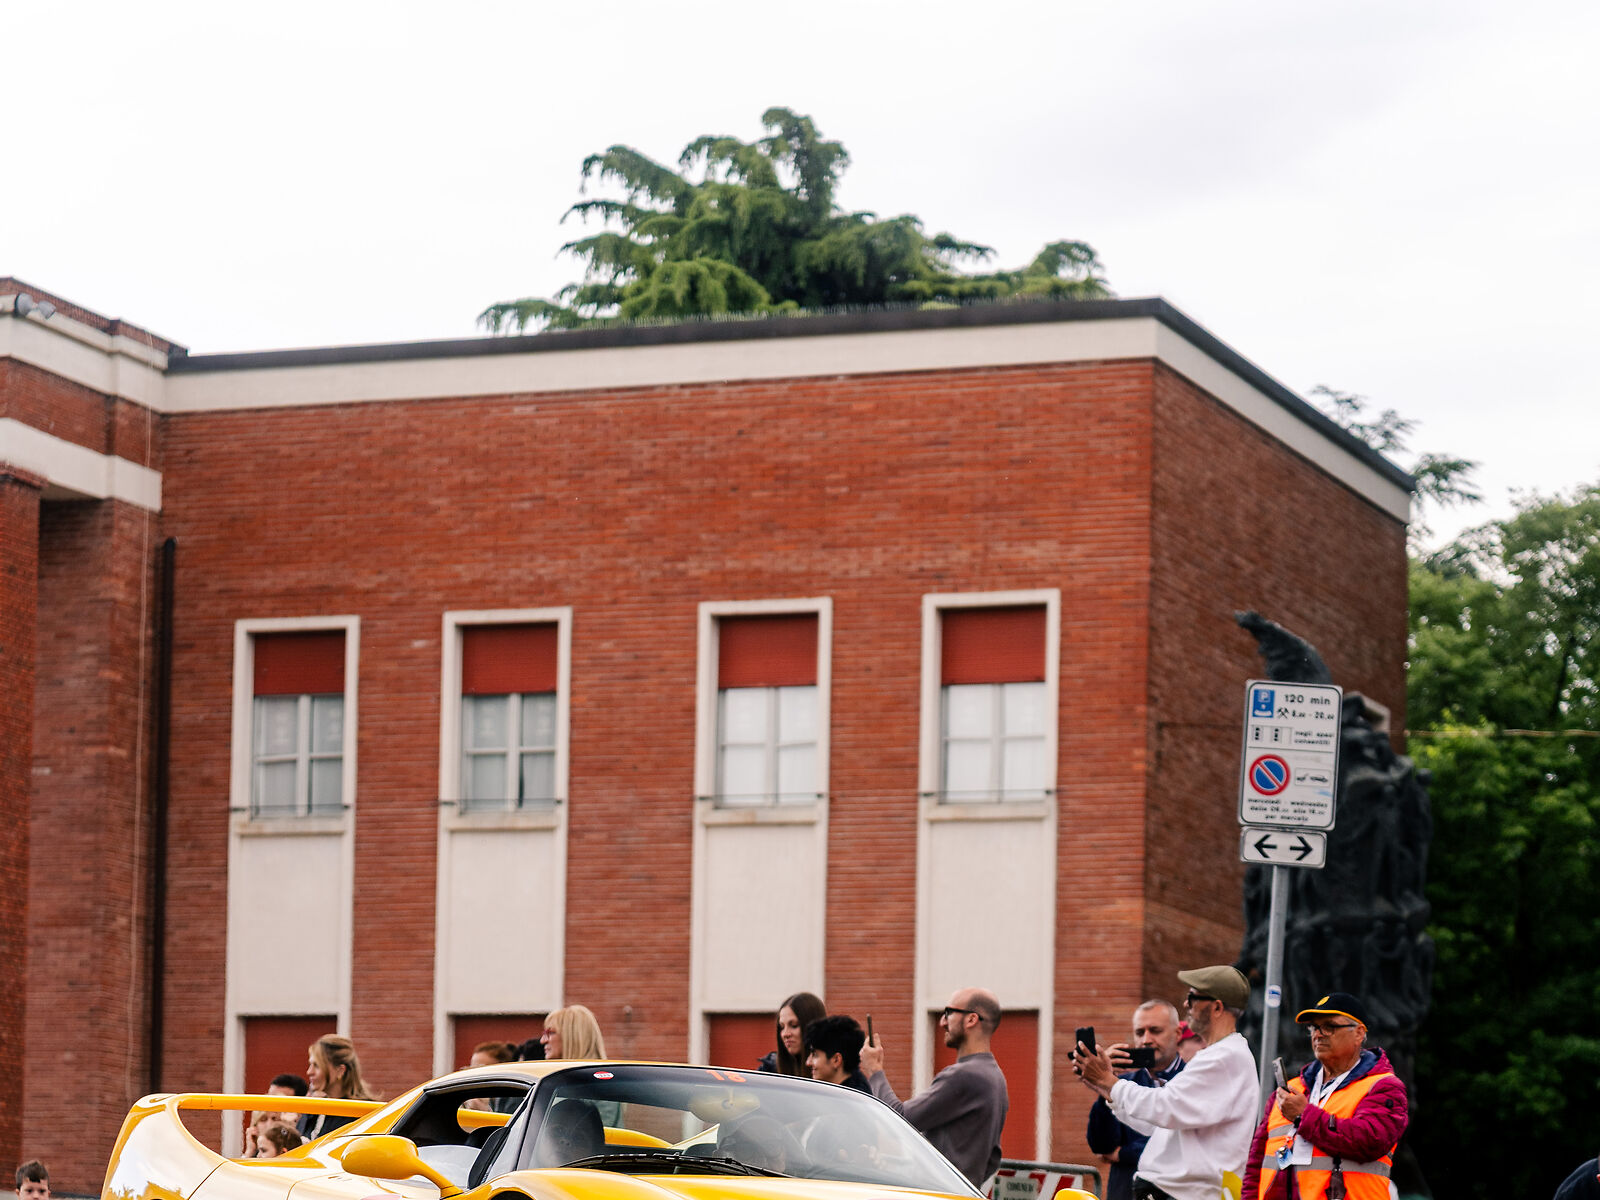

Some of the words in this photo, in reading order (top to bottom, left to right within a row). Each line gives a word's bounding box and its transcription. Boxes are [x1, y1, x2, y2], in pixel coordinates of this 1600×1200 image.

[1260, 691, 1268, 701] P
[1284, 694, 1304, 704] 120
[1310, 696, 1331, 705] min
